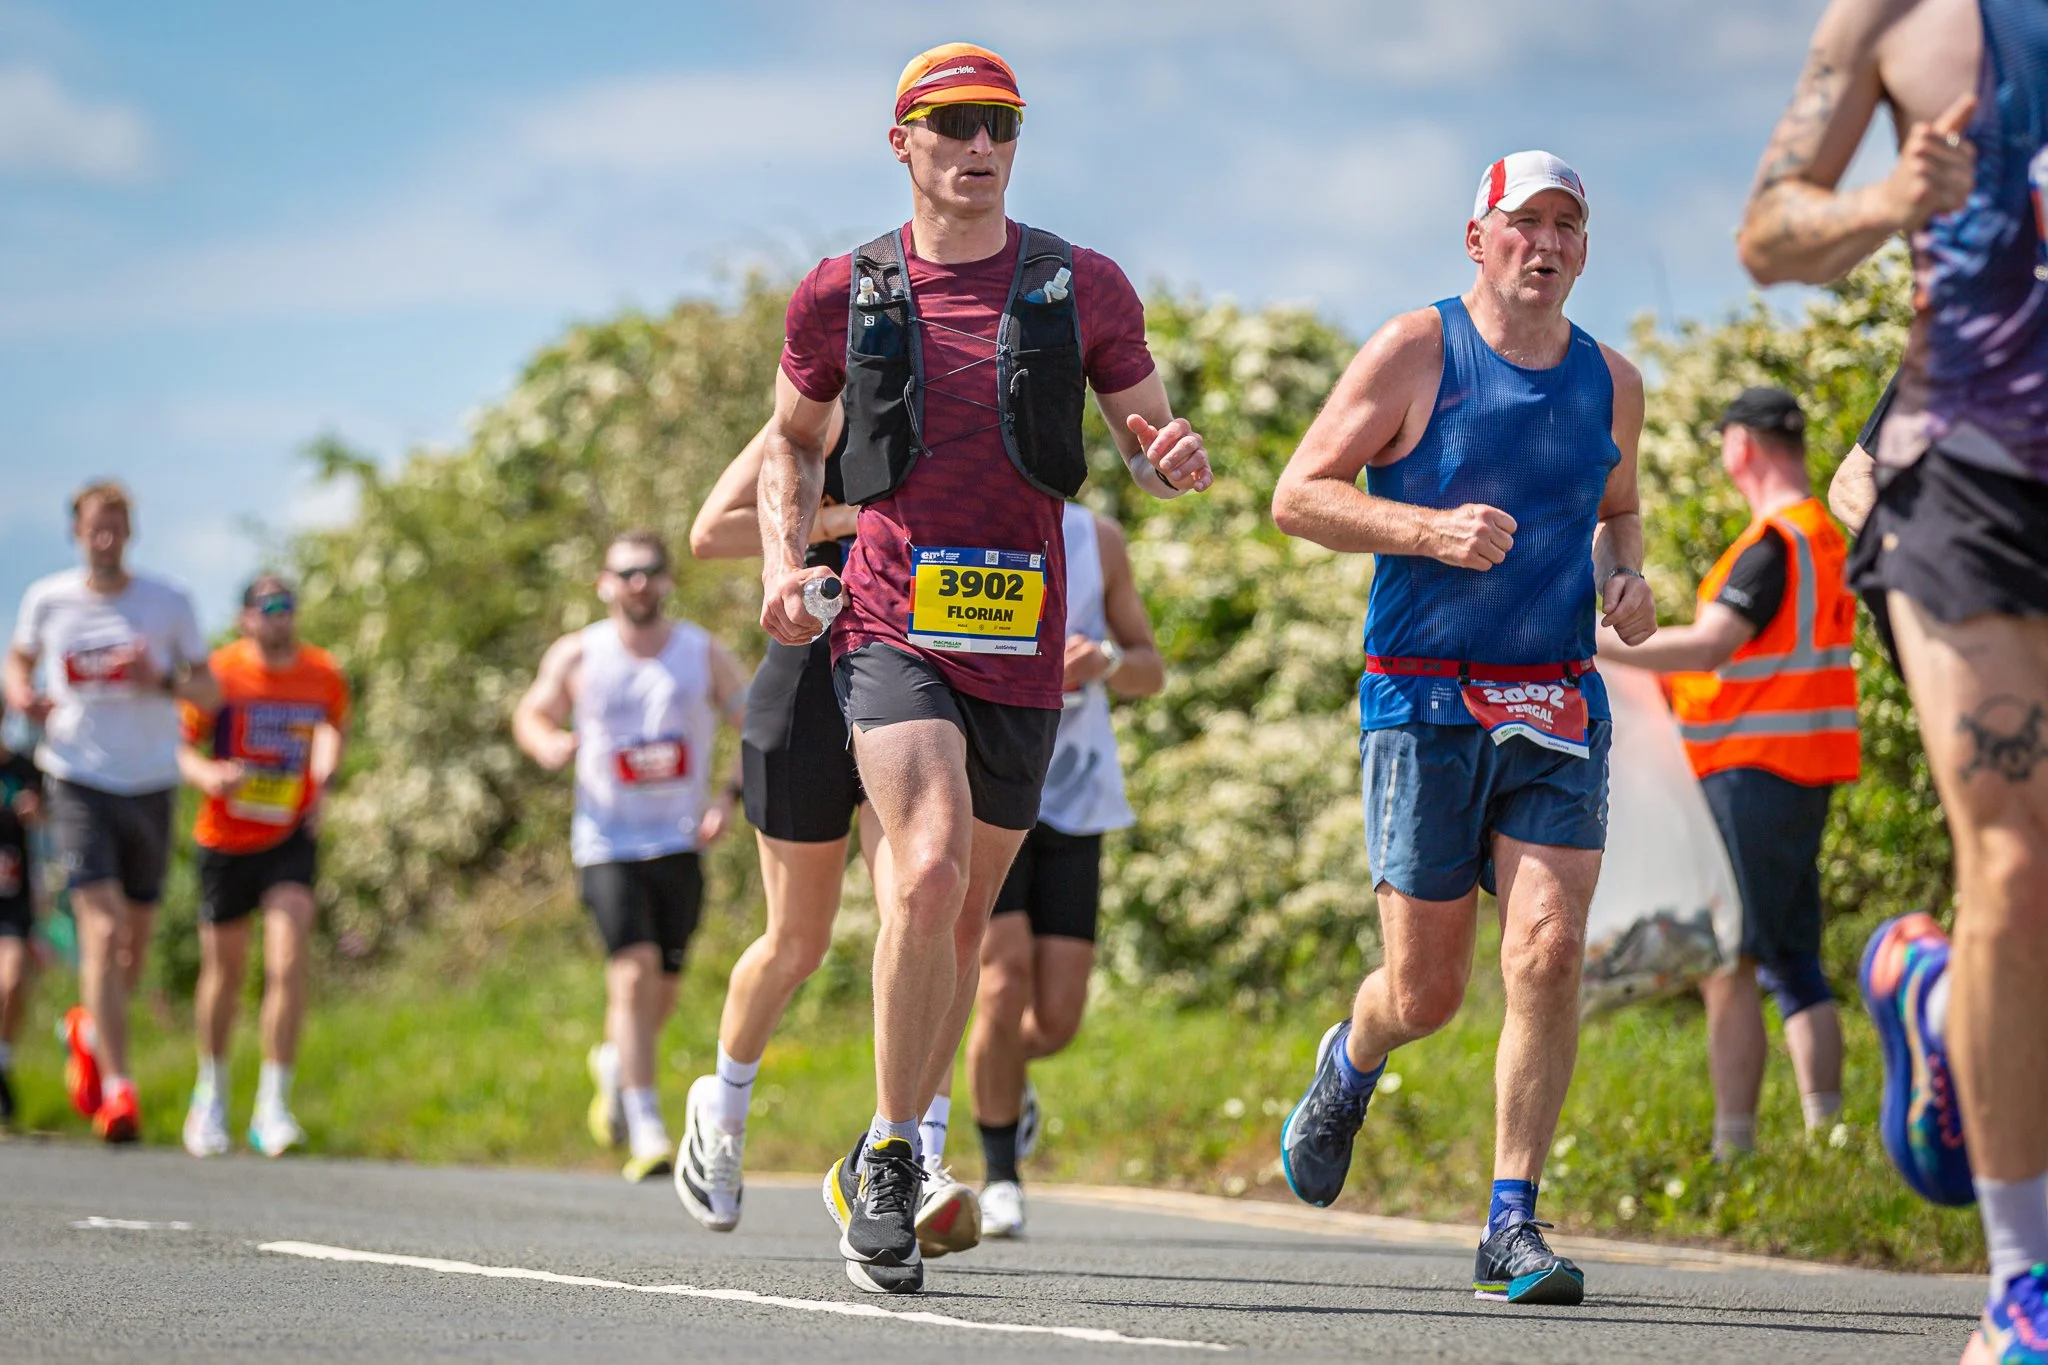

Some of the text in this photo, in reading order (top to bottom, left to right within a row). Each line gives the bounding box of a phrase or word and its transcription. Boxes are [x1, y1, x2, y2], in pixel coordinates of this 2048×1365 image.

[938, 569, 1024, 601] 3902
[947, 605, 1014, 622] FLORIAN
[1483, 684, 1565, 709] 2092
[1505, 703, 1554, 724] FERGAL
